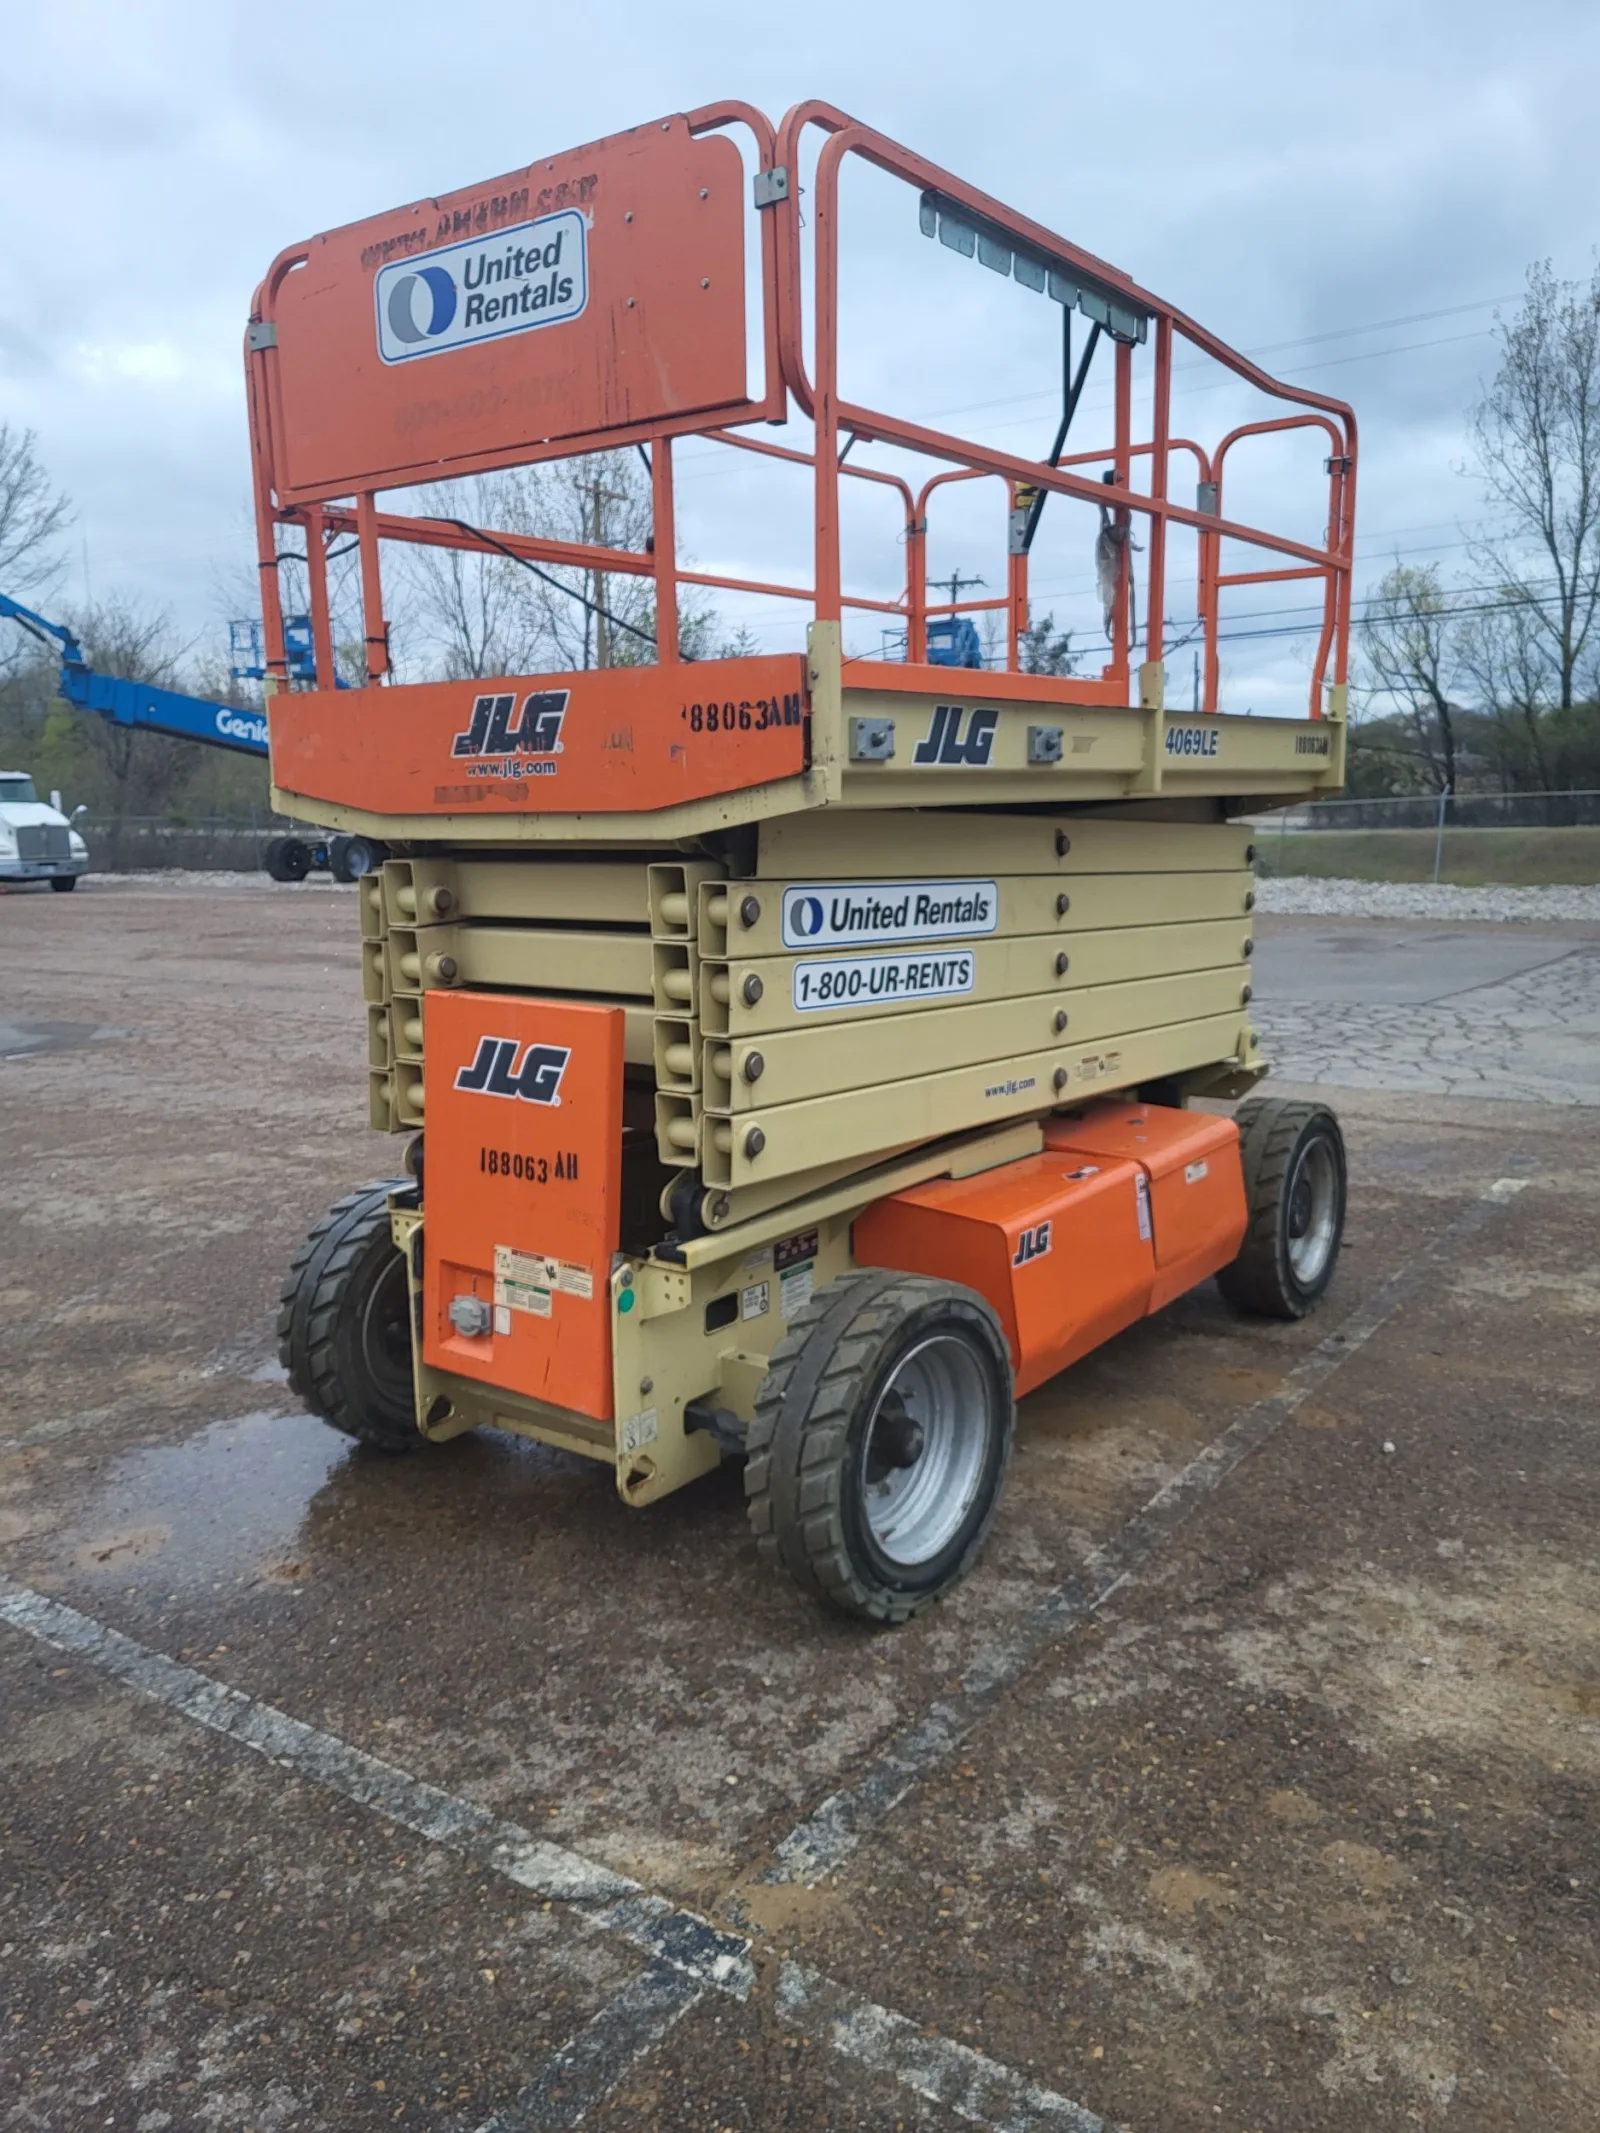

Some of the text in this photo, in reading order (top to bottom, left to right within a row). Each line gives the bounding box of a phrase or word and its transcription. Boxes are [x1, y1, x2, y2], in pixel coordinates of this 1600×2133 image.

[463, 231, 562, 290] United
[465, 270, 573, 328] Rentals
[453, 690, 569, 755] JLG
[914, 706, 997, 765] JLG
[1165, 727, 1219, 756] 4069LE
[830, 892, 988, 932] United Rentals
[799, 960, 970, 1002] 1-800-UR-RENTS
[454, 1037, 570, 1104] JLG
[984, 1077, 1036, 1097] www.jlg.com
[480, 1147, 548, 1183] 188063
[1013, 1222, 1051, 1266] JLG
